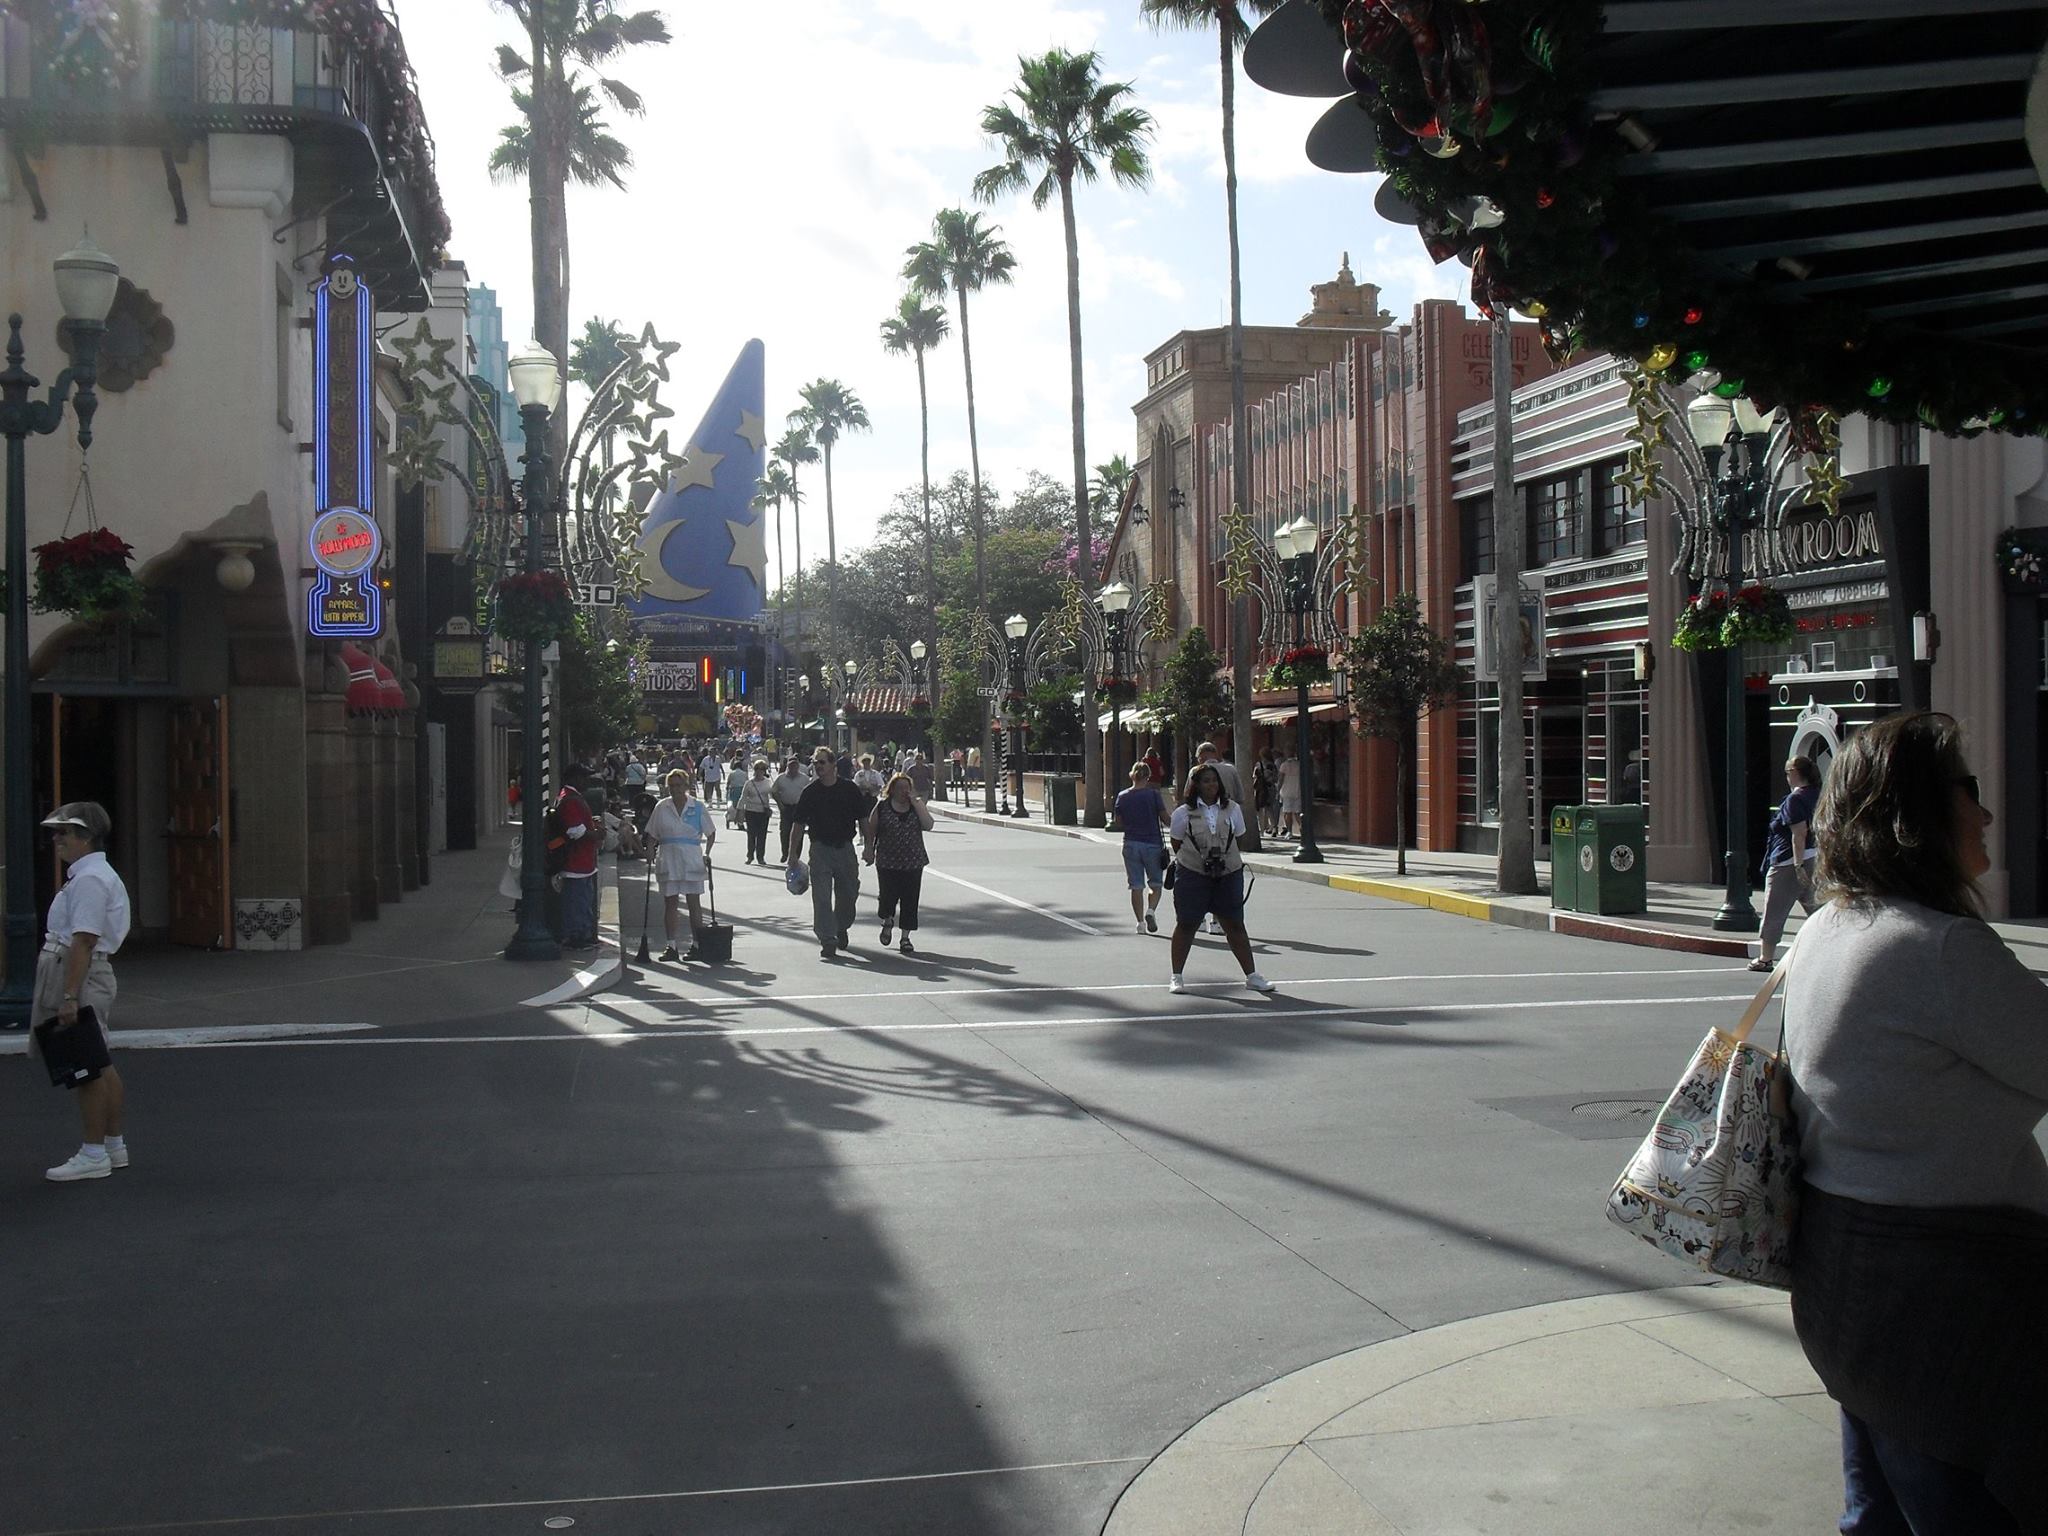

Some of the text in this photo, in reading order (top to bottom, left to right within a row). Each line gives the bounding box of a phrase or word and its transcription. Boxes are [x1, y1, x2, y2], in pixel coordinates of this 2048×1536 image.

[1462, 333, 1530, 361] CELEITY
[317, 531, 372, 556] HOLLYWOOD
[1788, 581, 1886, 609] GRAPHIC SUPPLIES
[655, 667, 696, 676] HOLLYWOOD
[643, 675, 696, 690] STUDIOS
[978, 688, 995, 696] GO
